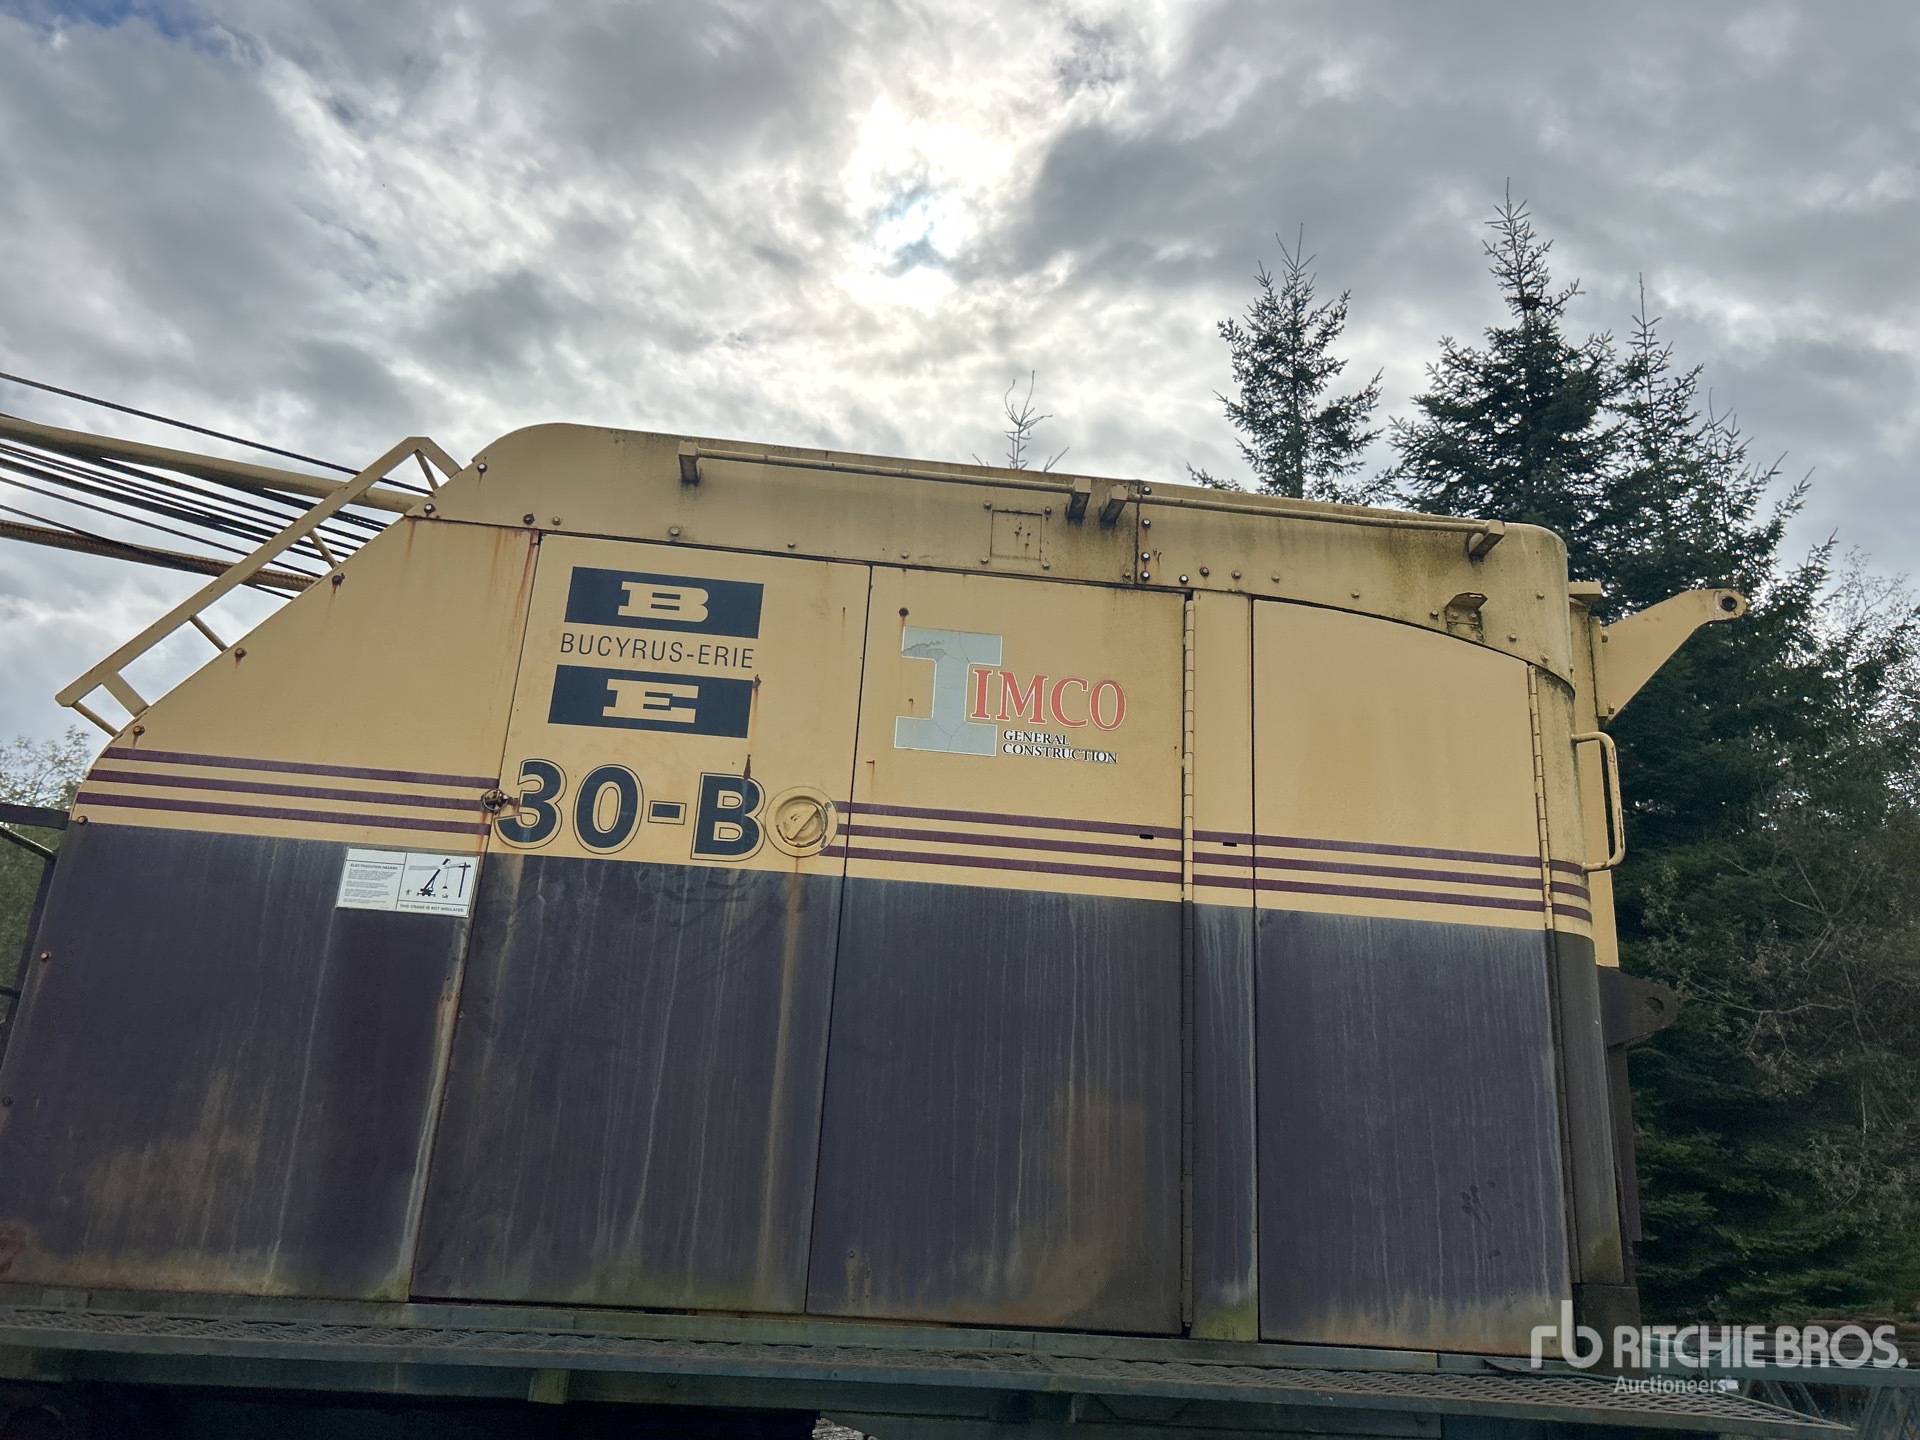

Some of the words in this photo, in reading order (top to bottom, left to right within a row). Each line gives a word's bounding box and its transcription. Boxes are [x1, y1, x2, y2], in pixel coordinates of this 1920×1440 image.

[617, 581, 710, 623] B
[560, 633, 755, 669] BUCYRUS-ERIE
[602, 678, 700, 724] E
[970, 668, 1127, 731] IMCO
[1002, 729, 1070, 746] GENERAL
[1002, 743, 1119, 764] CONSTRUCTION
[493, 758, 766, 862] 30-B
